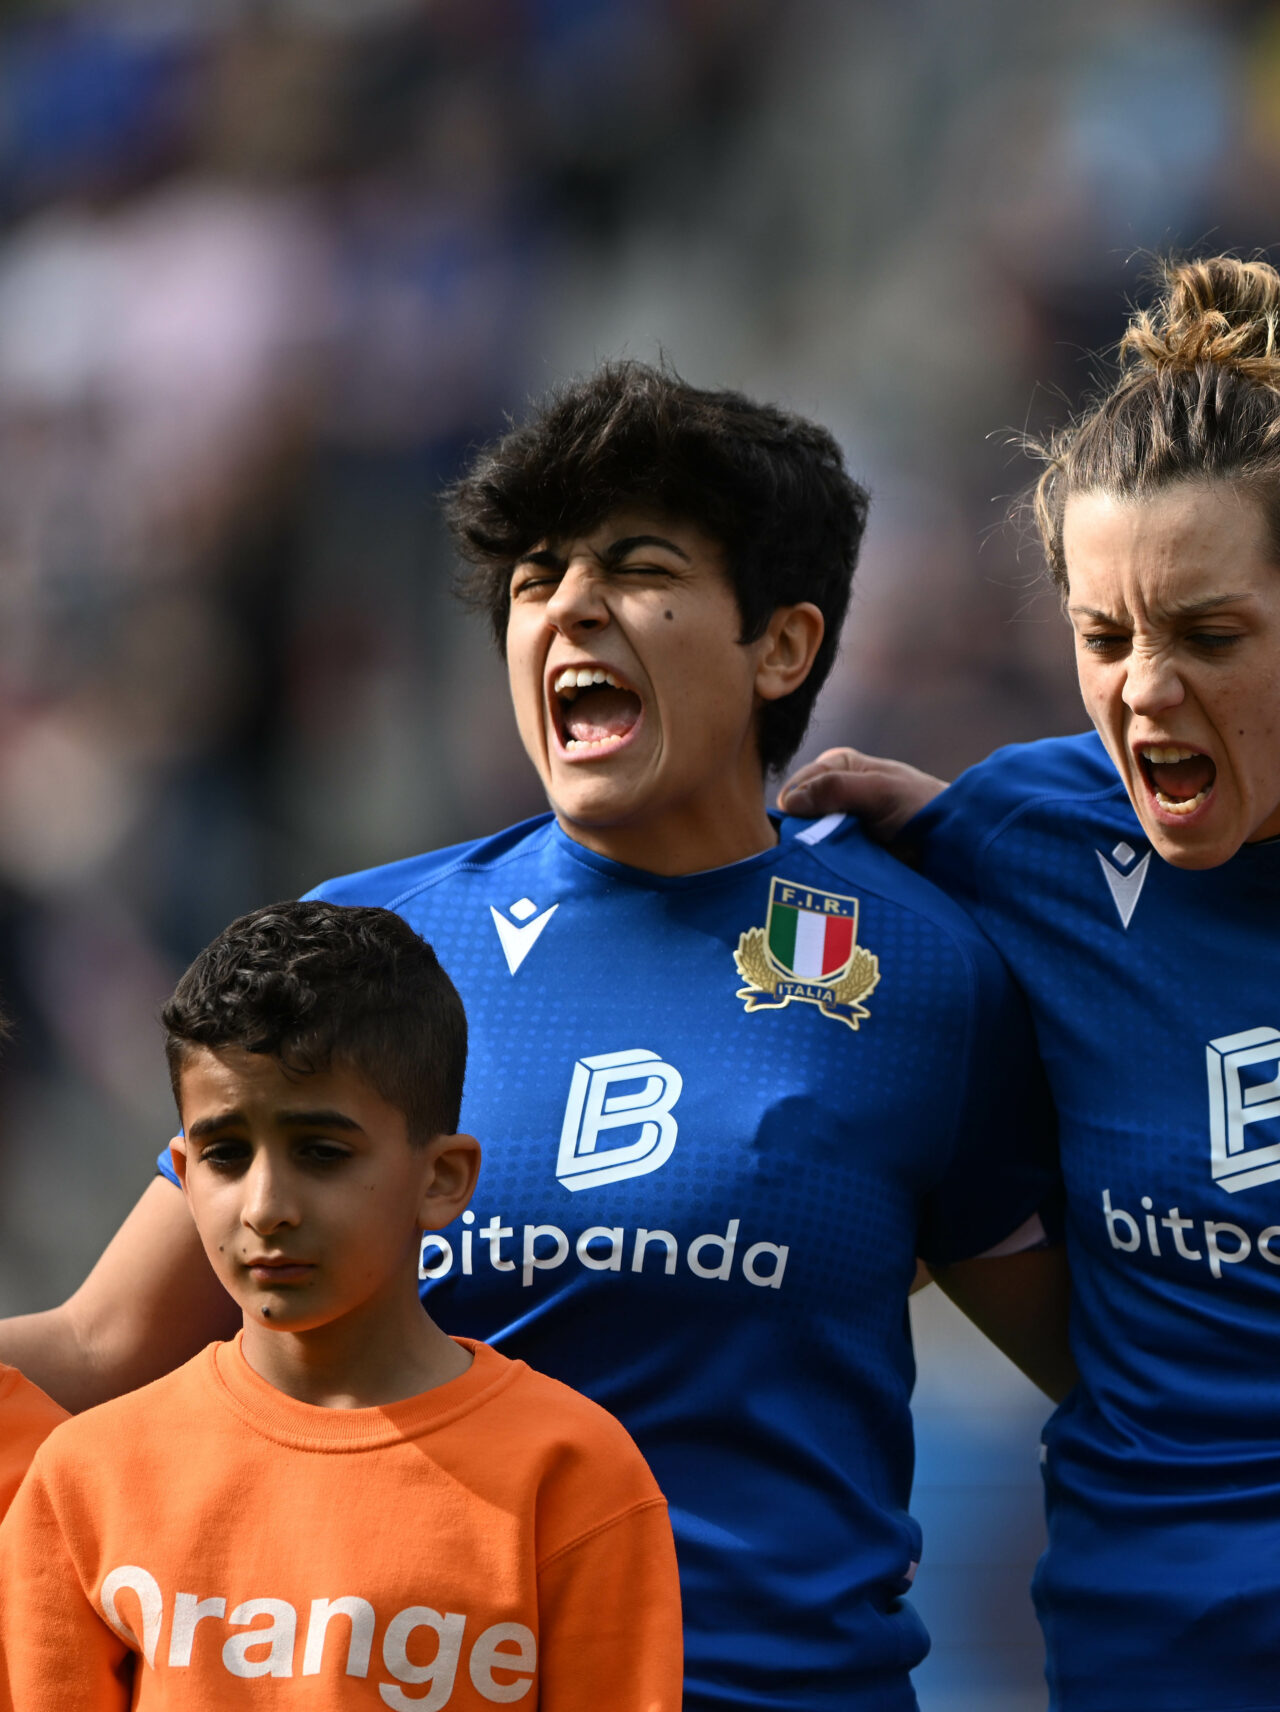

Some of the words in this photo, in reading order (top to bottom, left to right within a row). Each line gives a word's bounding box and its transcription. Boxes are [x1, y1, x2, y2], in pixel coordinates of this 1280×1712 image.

[782, 887, 848, 915] F.I.R.
[778, 982, 834, 1003] ITALIA
[99, 1564, 538, 1712] Orange
